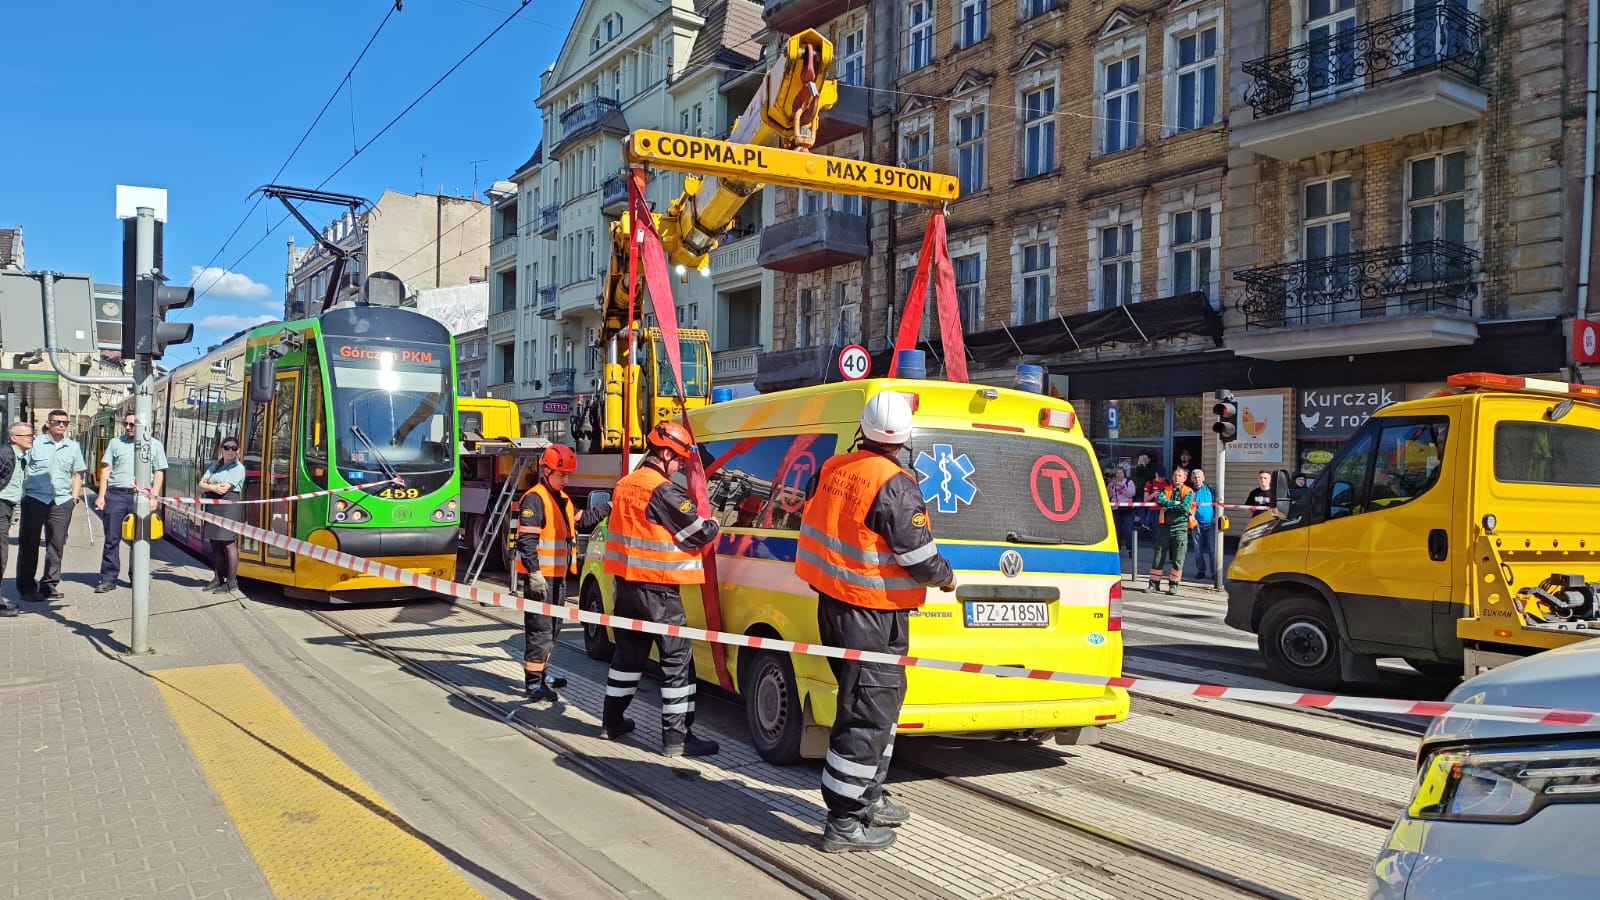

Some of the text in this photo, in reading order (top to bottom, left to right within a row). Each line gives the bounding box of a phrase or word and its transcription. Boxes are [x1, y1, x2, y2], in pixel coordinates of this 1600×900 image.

[657, 135, 768, 170] COPMA.PL
[826, 160, 932, 193] MAX 19TON
[340, 345, 432, 364] Górczn PKM
[843, 354, 867, 373] 40
[1304, 387, 1394, 408] Kurczak
[1324, 411, 1371, 428] z roż
[379, 487, 419, 499] 459
[976, 604, 997, 622] PZ
[1000, 604, 1046, 622] 218SN
